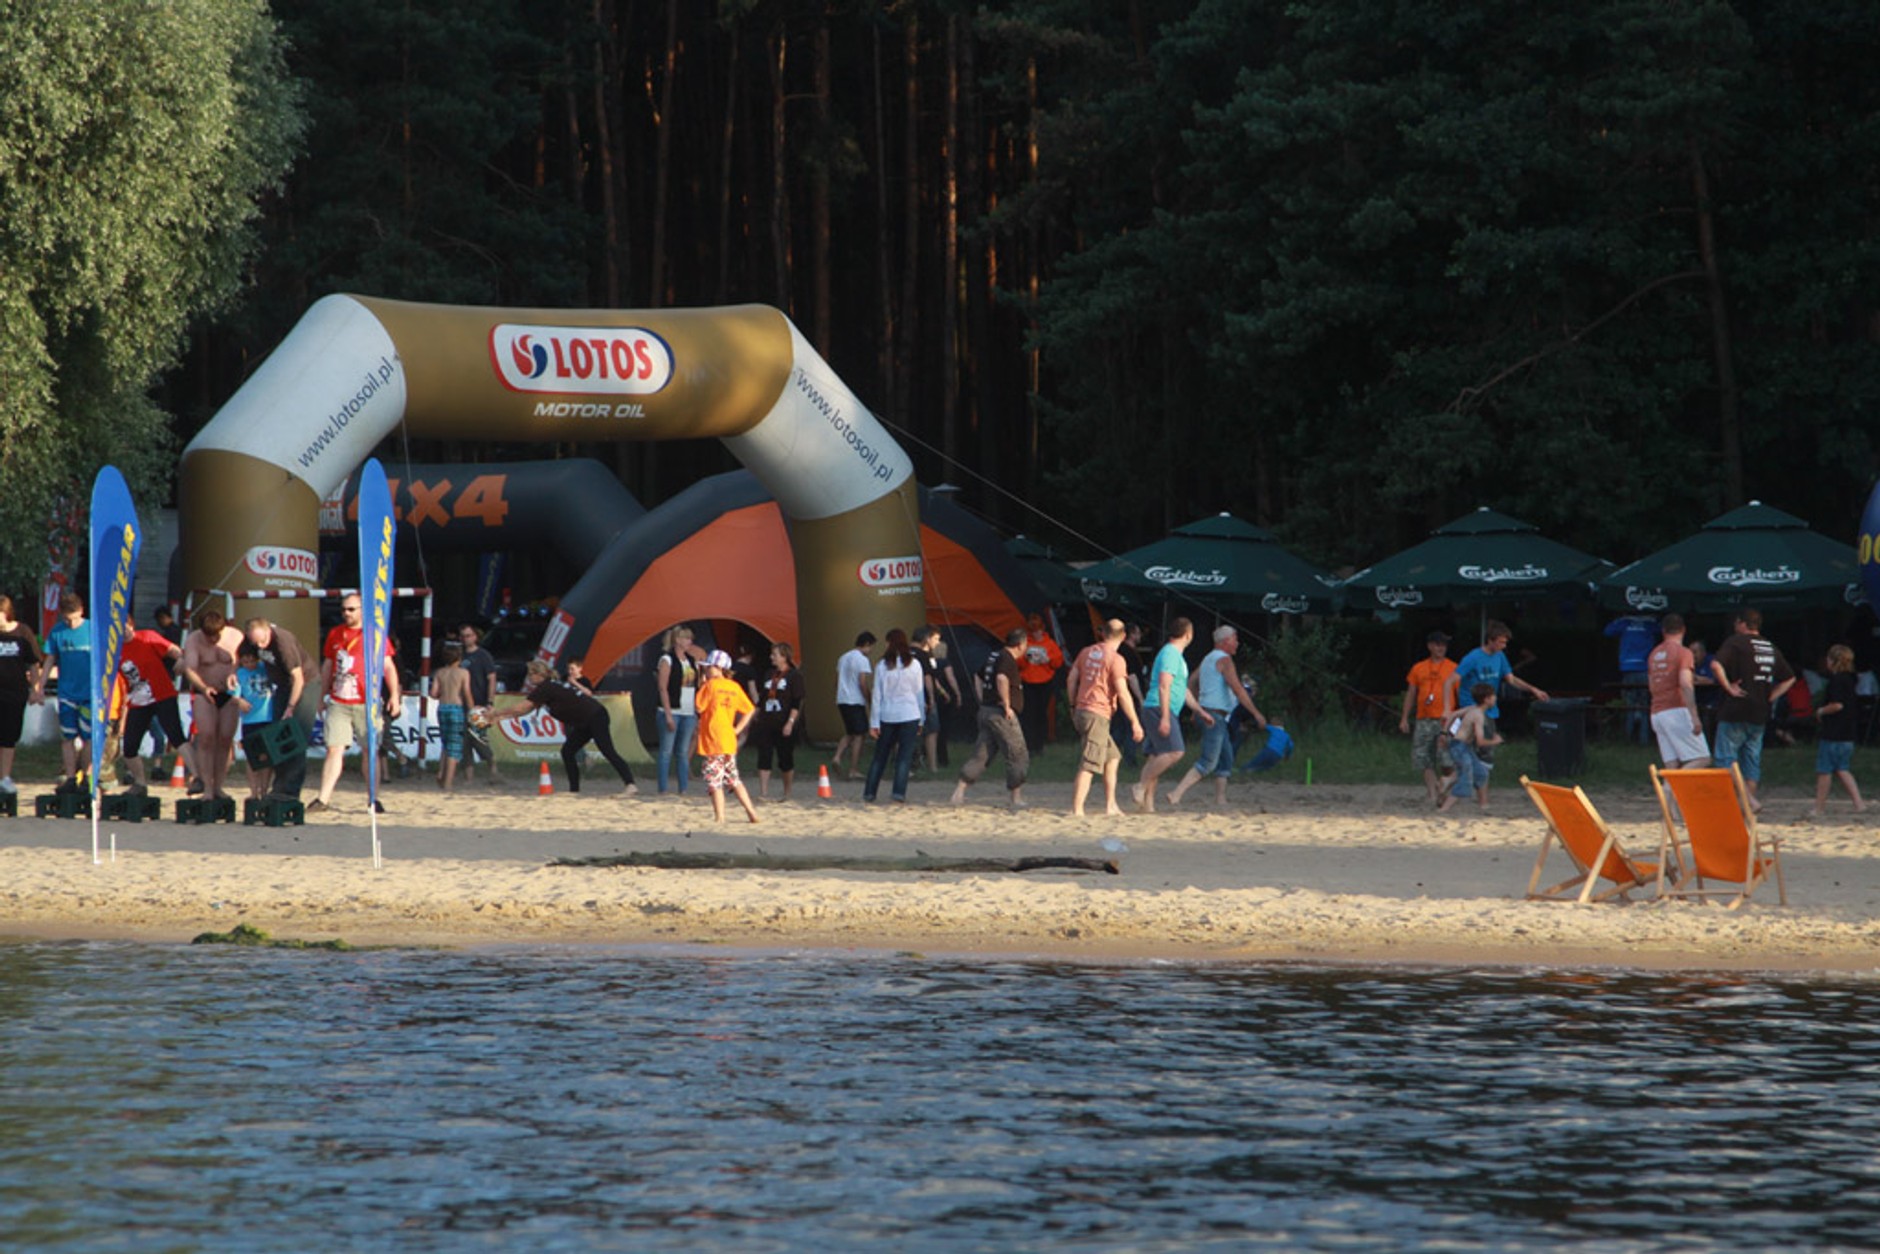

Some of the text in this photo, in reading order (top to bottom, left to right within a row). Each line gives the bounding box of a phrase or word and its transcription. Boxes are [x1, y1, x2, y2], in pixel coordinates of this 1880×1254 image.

[550, 337, 653, 380] LOTOS
[298, 356, 394, 468] www.lotosoil.pl
[533, 402, 646, 418] MOTOR OIL
[797, 368, 894, 482] www.lotosoil.pl
[1144, 565, 1228, 587] Carlsberg
[1458, 564, 1548, 582] Carlsberg
[1707, 565, 1800, 587] Carlsberg
[1375, 584, 1424, 608] Carlsberg
